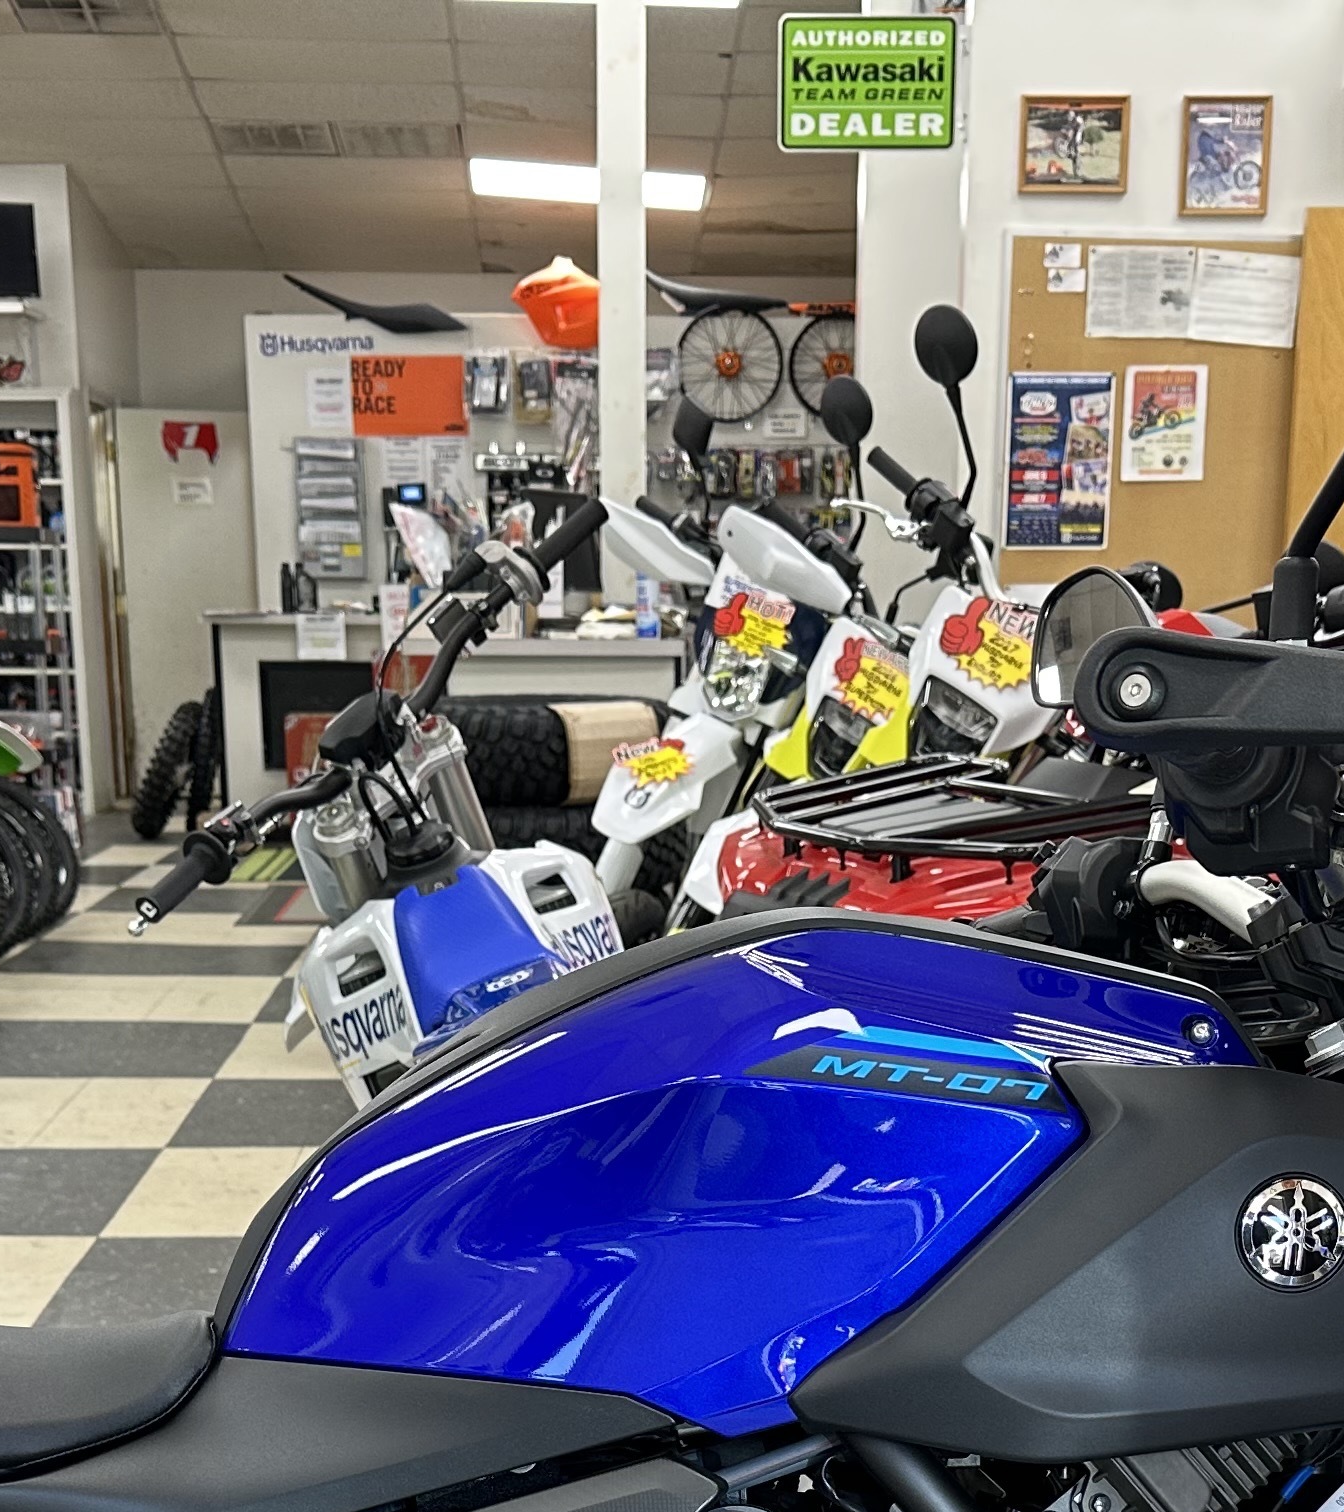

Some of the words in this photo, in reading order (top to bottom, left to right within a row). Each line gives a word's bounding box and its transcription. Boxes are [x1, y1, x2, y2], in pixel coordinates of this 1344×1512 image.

[791, 29, 946, 48] AUTHORIZED
[792, 56, 945, 85] Kawasaki
[792, 88, 859, 102] TEAM
[864, 88, 946, 102] GREEN
[791, 110, 945, 138] DEALER
[280, 335, 374, 354] Husqvarna
[352, 359, 406, 378] READY
[353, 379, 374, 395] TO
[353, 396, 396, 415] RACE
[323, 983, 406, 1061] usqvarna
[811, 1055, 1051, 1103] MT-07
